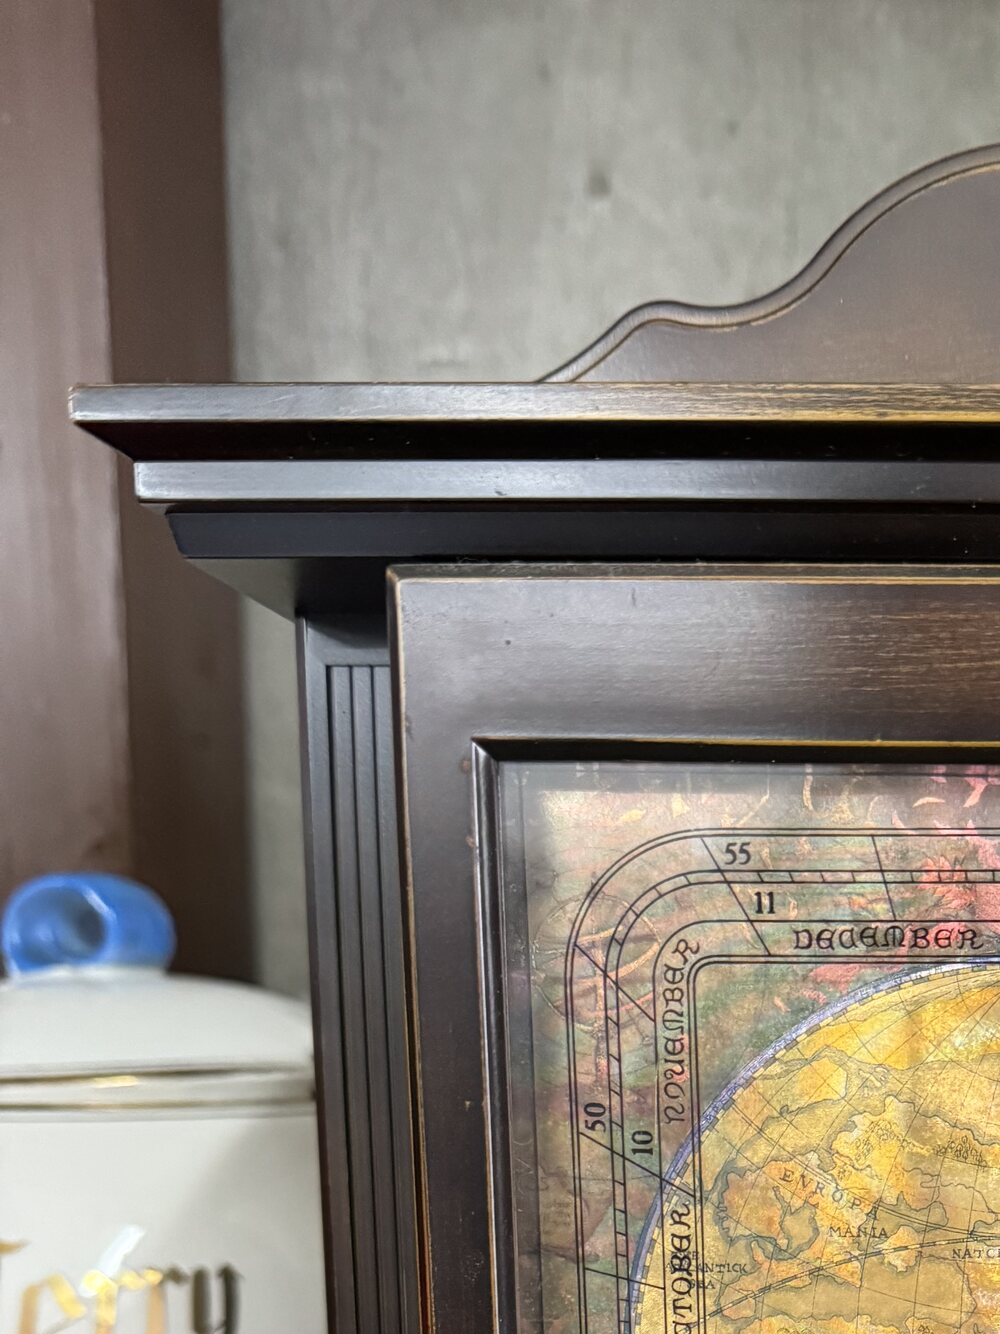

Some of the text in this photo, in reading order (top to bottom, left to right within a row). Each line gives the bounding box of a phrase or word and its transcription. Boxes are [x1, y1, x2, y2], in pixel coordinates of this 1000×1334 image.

[724, 842, 751, 866] 55
[754, 891, 776, 915] 11
[793, 925, 984, 950] DECEMBER
[583, 1102, 606, 1133] 50
[631, 1130, 654, 1156] 10
